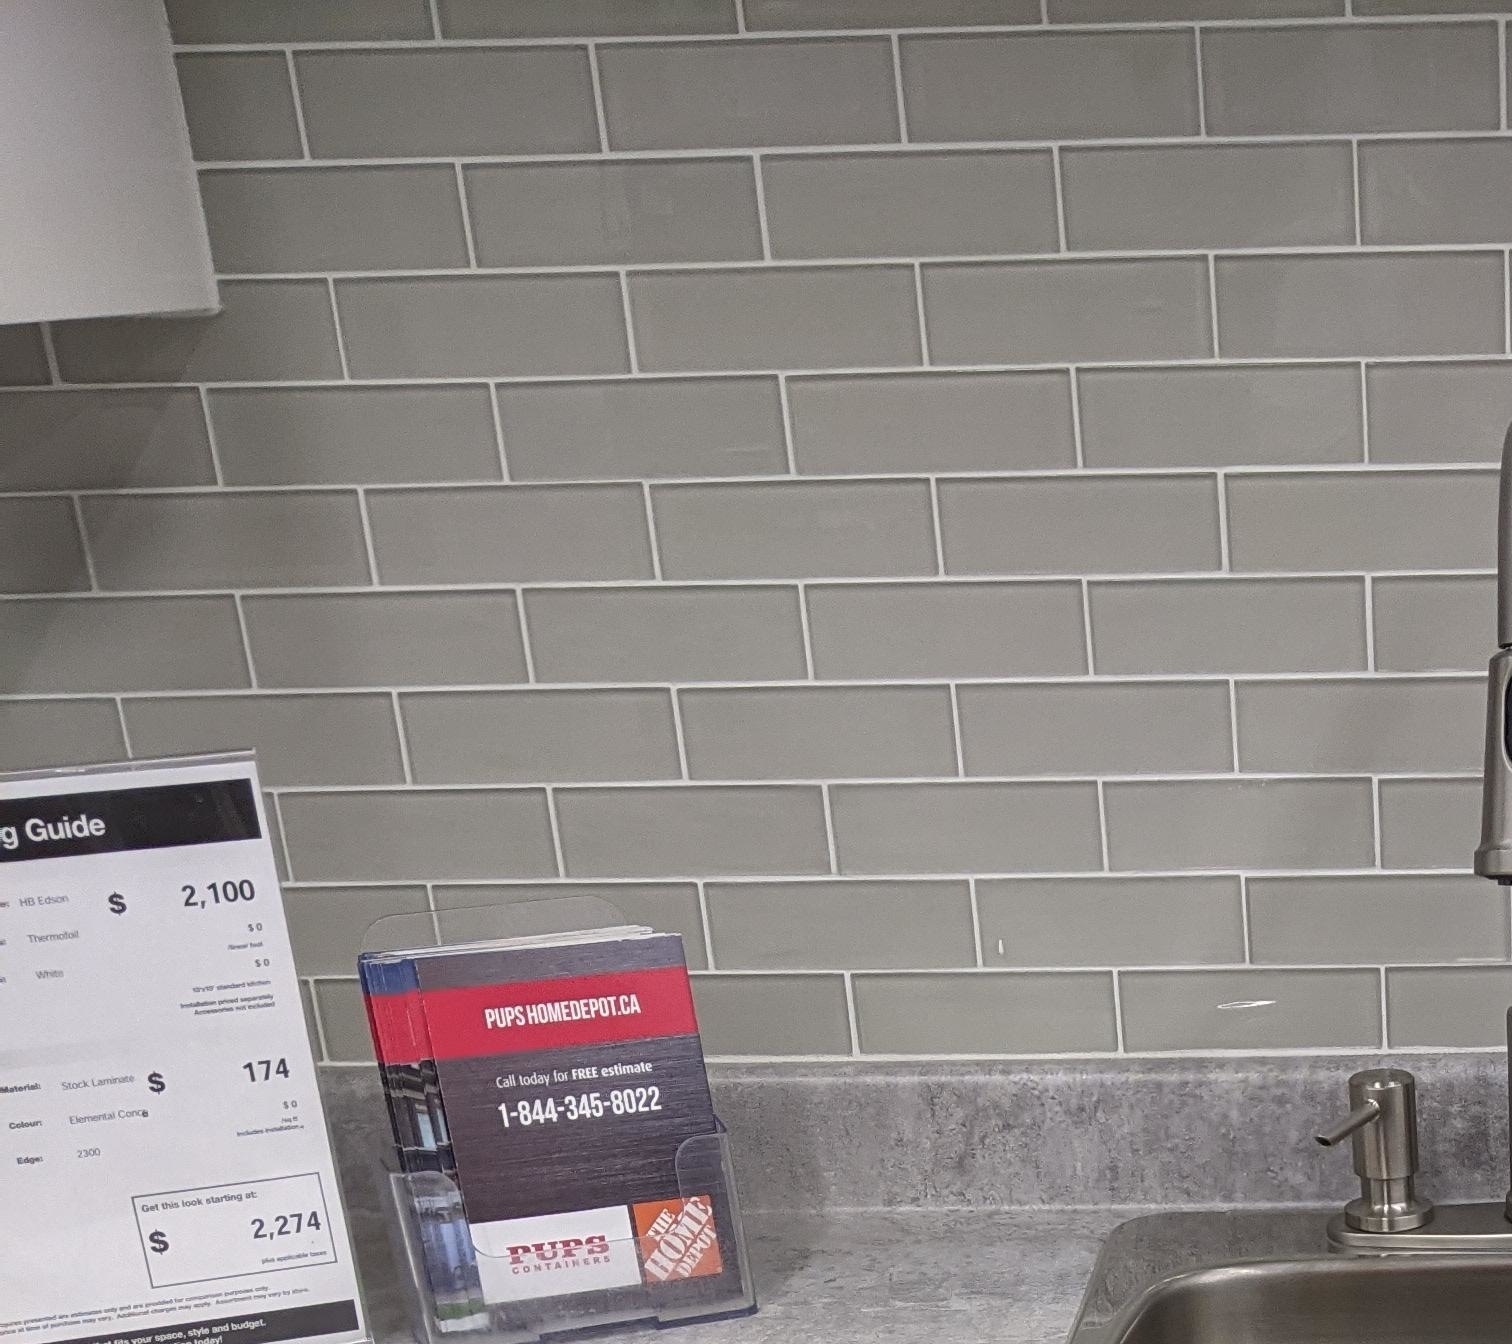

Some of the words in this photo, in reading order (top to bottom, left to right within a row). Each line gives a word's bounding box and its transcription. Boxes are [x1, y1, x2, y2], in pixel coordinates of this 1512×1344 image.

[25, 814, 106, 842] Guide
[108, 891, 127, 916] $
[181, 879, 256, 909] 2,100
[484, 1004, 526, 1029] PUPS
[526, 993, 642, 1026] HOMEDEPOT.CA
[62, 1080, 90, 1091] Stock
[92, 1074, 135, 1087] Laminate
[147, 1070, 166, 1095] $
[243, 1057, 290, 1083] 174
[496, 1074, 517, 1089] Call
[519, 1071, 550, 1087] today
[552, 1068, 569, 1082] for
[571, 1066, 599, 1081] FREE
[601, 1061, 653, 1078] estimate
[69, 1111, 116, 1125] Elemental
[497, 1086, 662, 1128] 1-844-345-8022
[77, 1147, 101, 1159] 2300
[141, 1203, 160, 1214] Get
[161, 1200, 180, 1210] this
[182, 1197, 204, 1208] look
[206, 1193, 243, 1206] starting
[148, 1228, 169, 1255] $
[250, 1210, 321, 1241] 2,274
[644, 1196, 713, 1281] HOME
[646, 1207, 676, 1240] THE
[505, 1234, 610, 1266] PUPS
[511, 1255, 611, 1275] CONTAINERS
[674, 1223, 717, 1278] DEPOT
[188, 1326, 210, 1338] style
[212, 1322, 229, 1334] and
